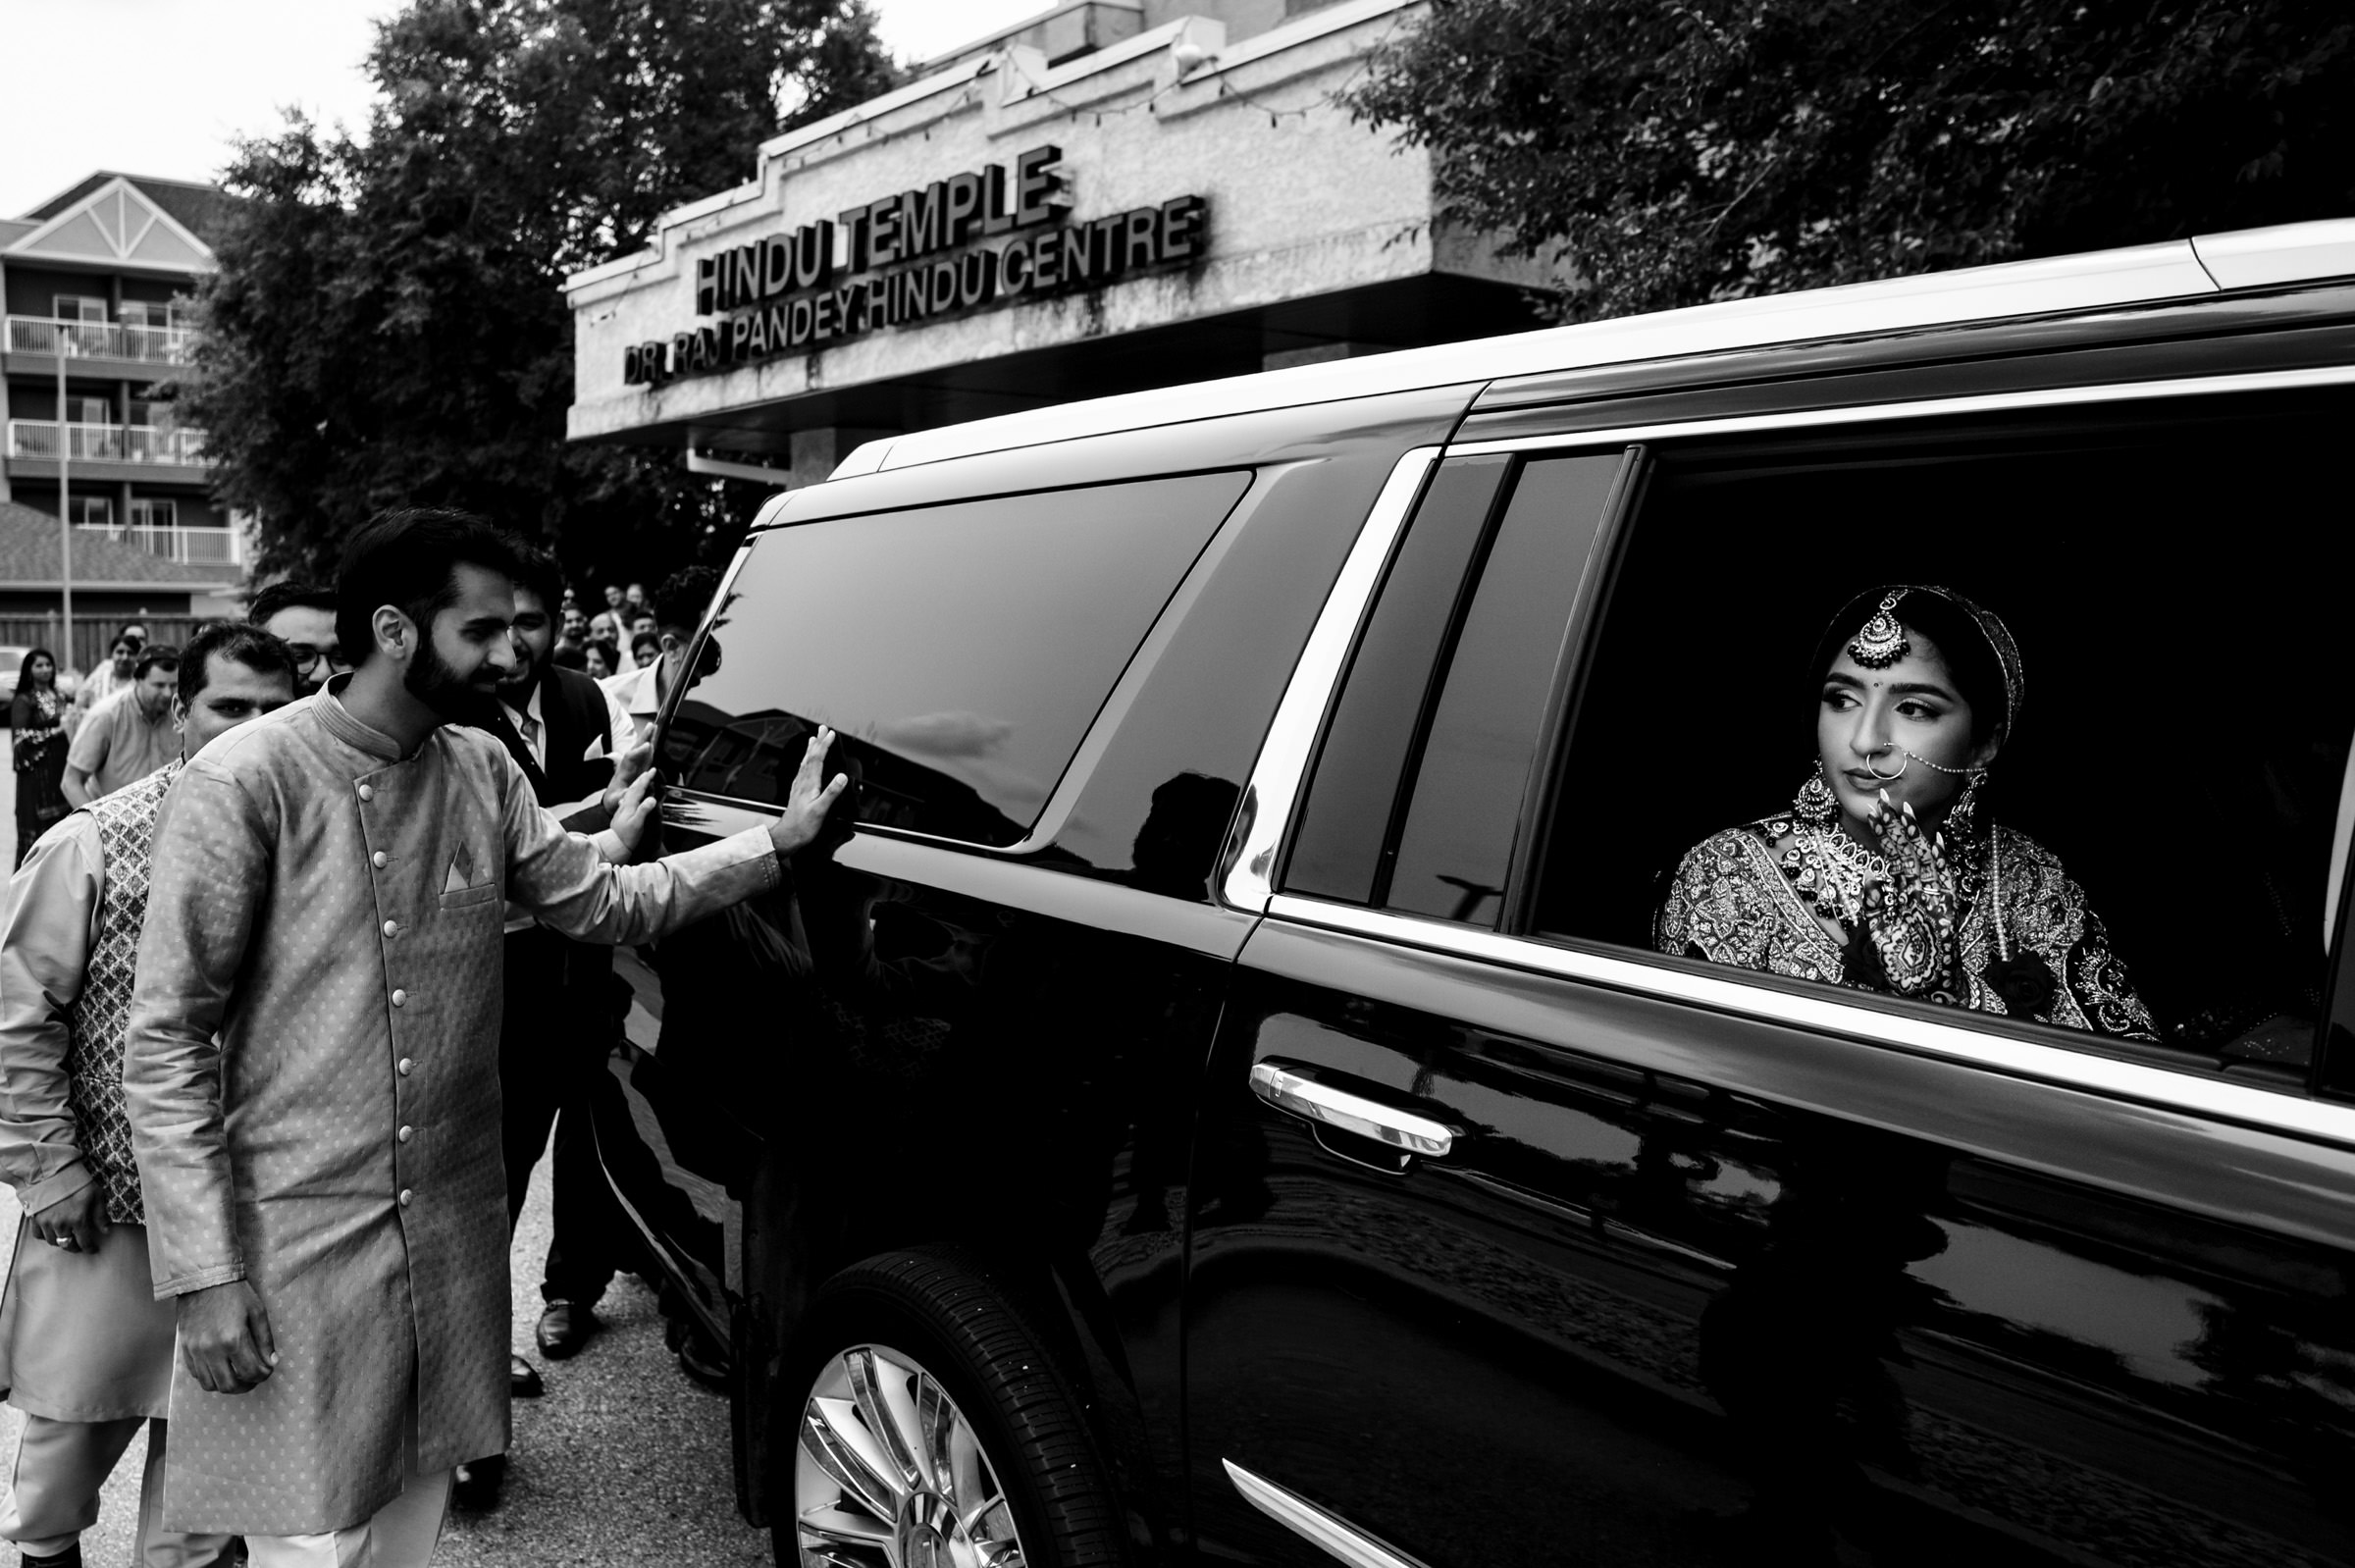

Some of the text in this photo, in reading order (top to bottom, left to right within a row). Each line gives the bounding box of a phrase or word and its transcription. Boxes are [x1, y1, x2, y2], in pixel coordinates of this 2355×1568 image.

[673, 322, 723, 375] RAJ
[732, 285, 856, 358] PANDEY
[866, 250, 987, 328] HINDU
[1001, 195, 1193, 295] CENTRE
[697, 144, 1055, 315] HINDU TEMPLE
